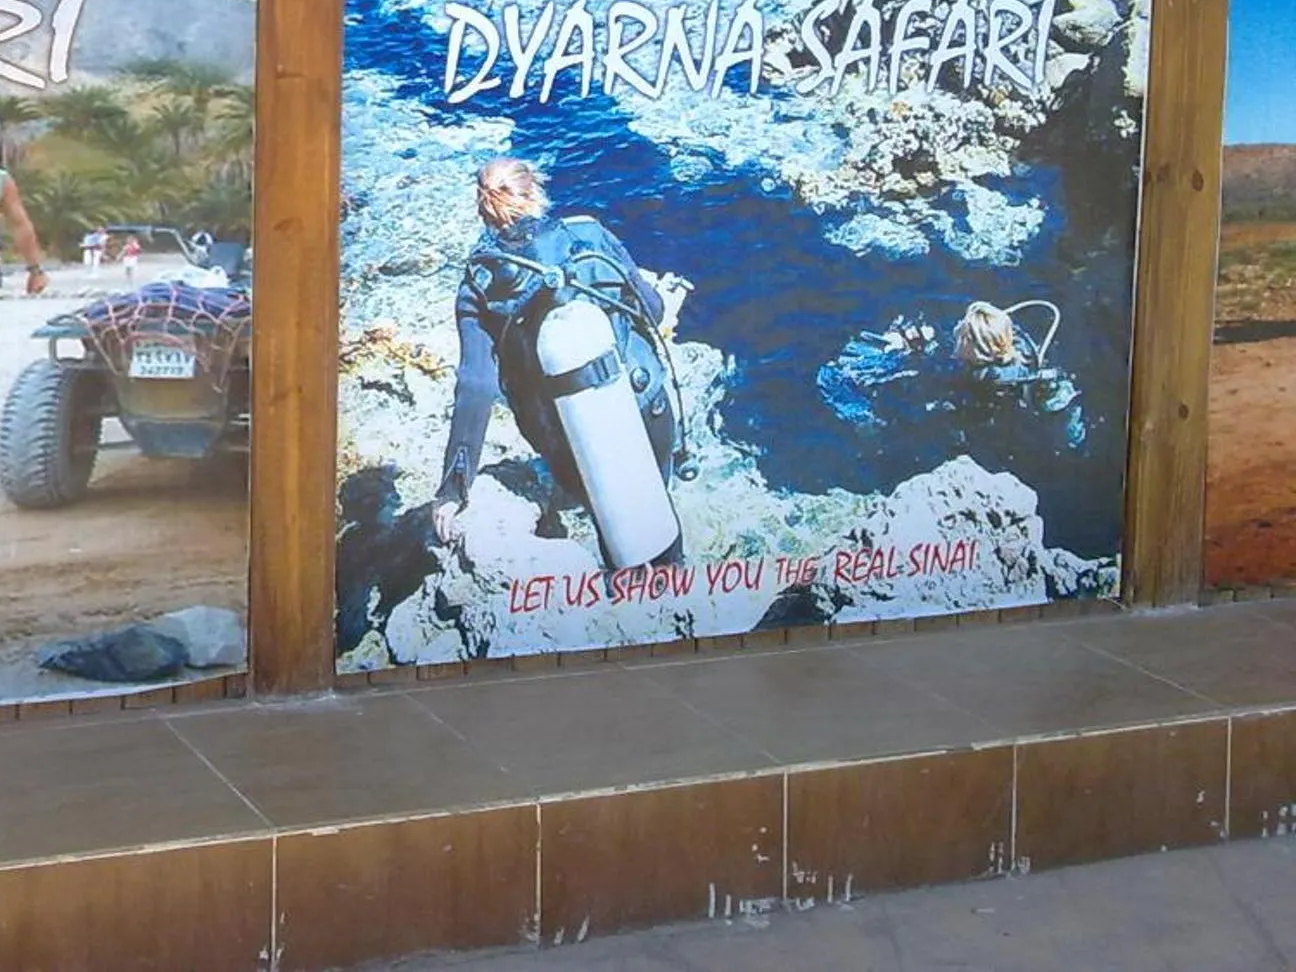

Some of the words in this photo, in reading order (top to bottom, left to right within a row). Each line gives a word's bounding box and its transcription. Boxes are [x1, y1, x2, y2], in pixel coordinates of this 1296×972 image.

[508, 576, 555, 614] LET
[562, 571, 604, 608] US
[610, 564, 696, 605] SHOW
[706, 557, 766, 594] YOU
[775, 555, 818, 586] THE
[833, 546, 898, 585] REAL
